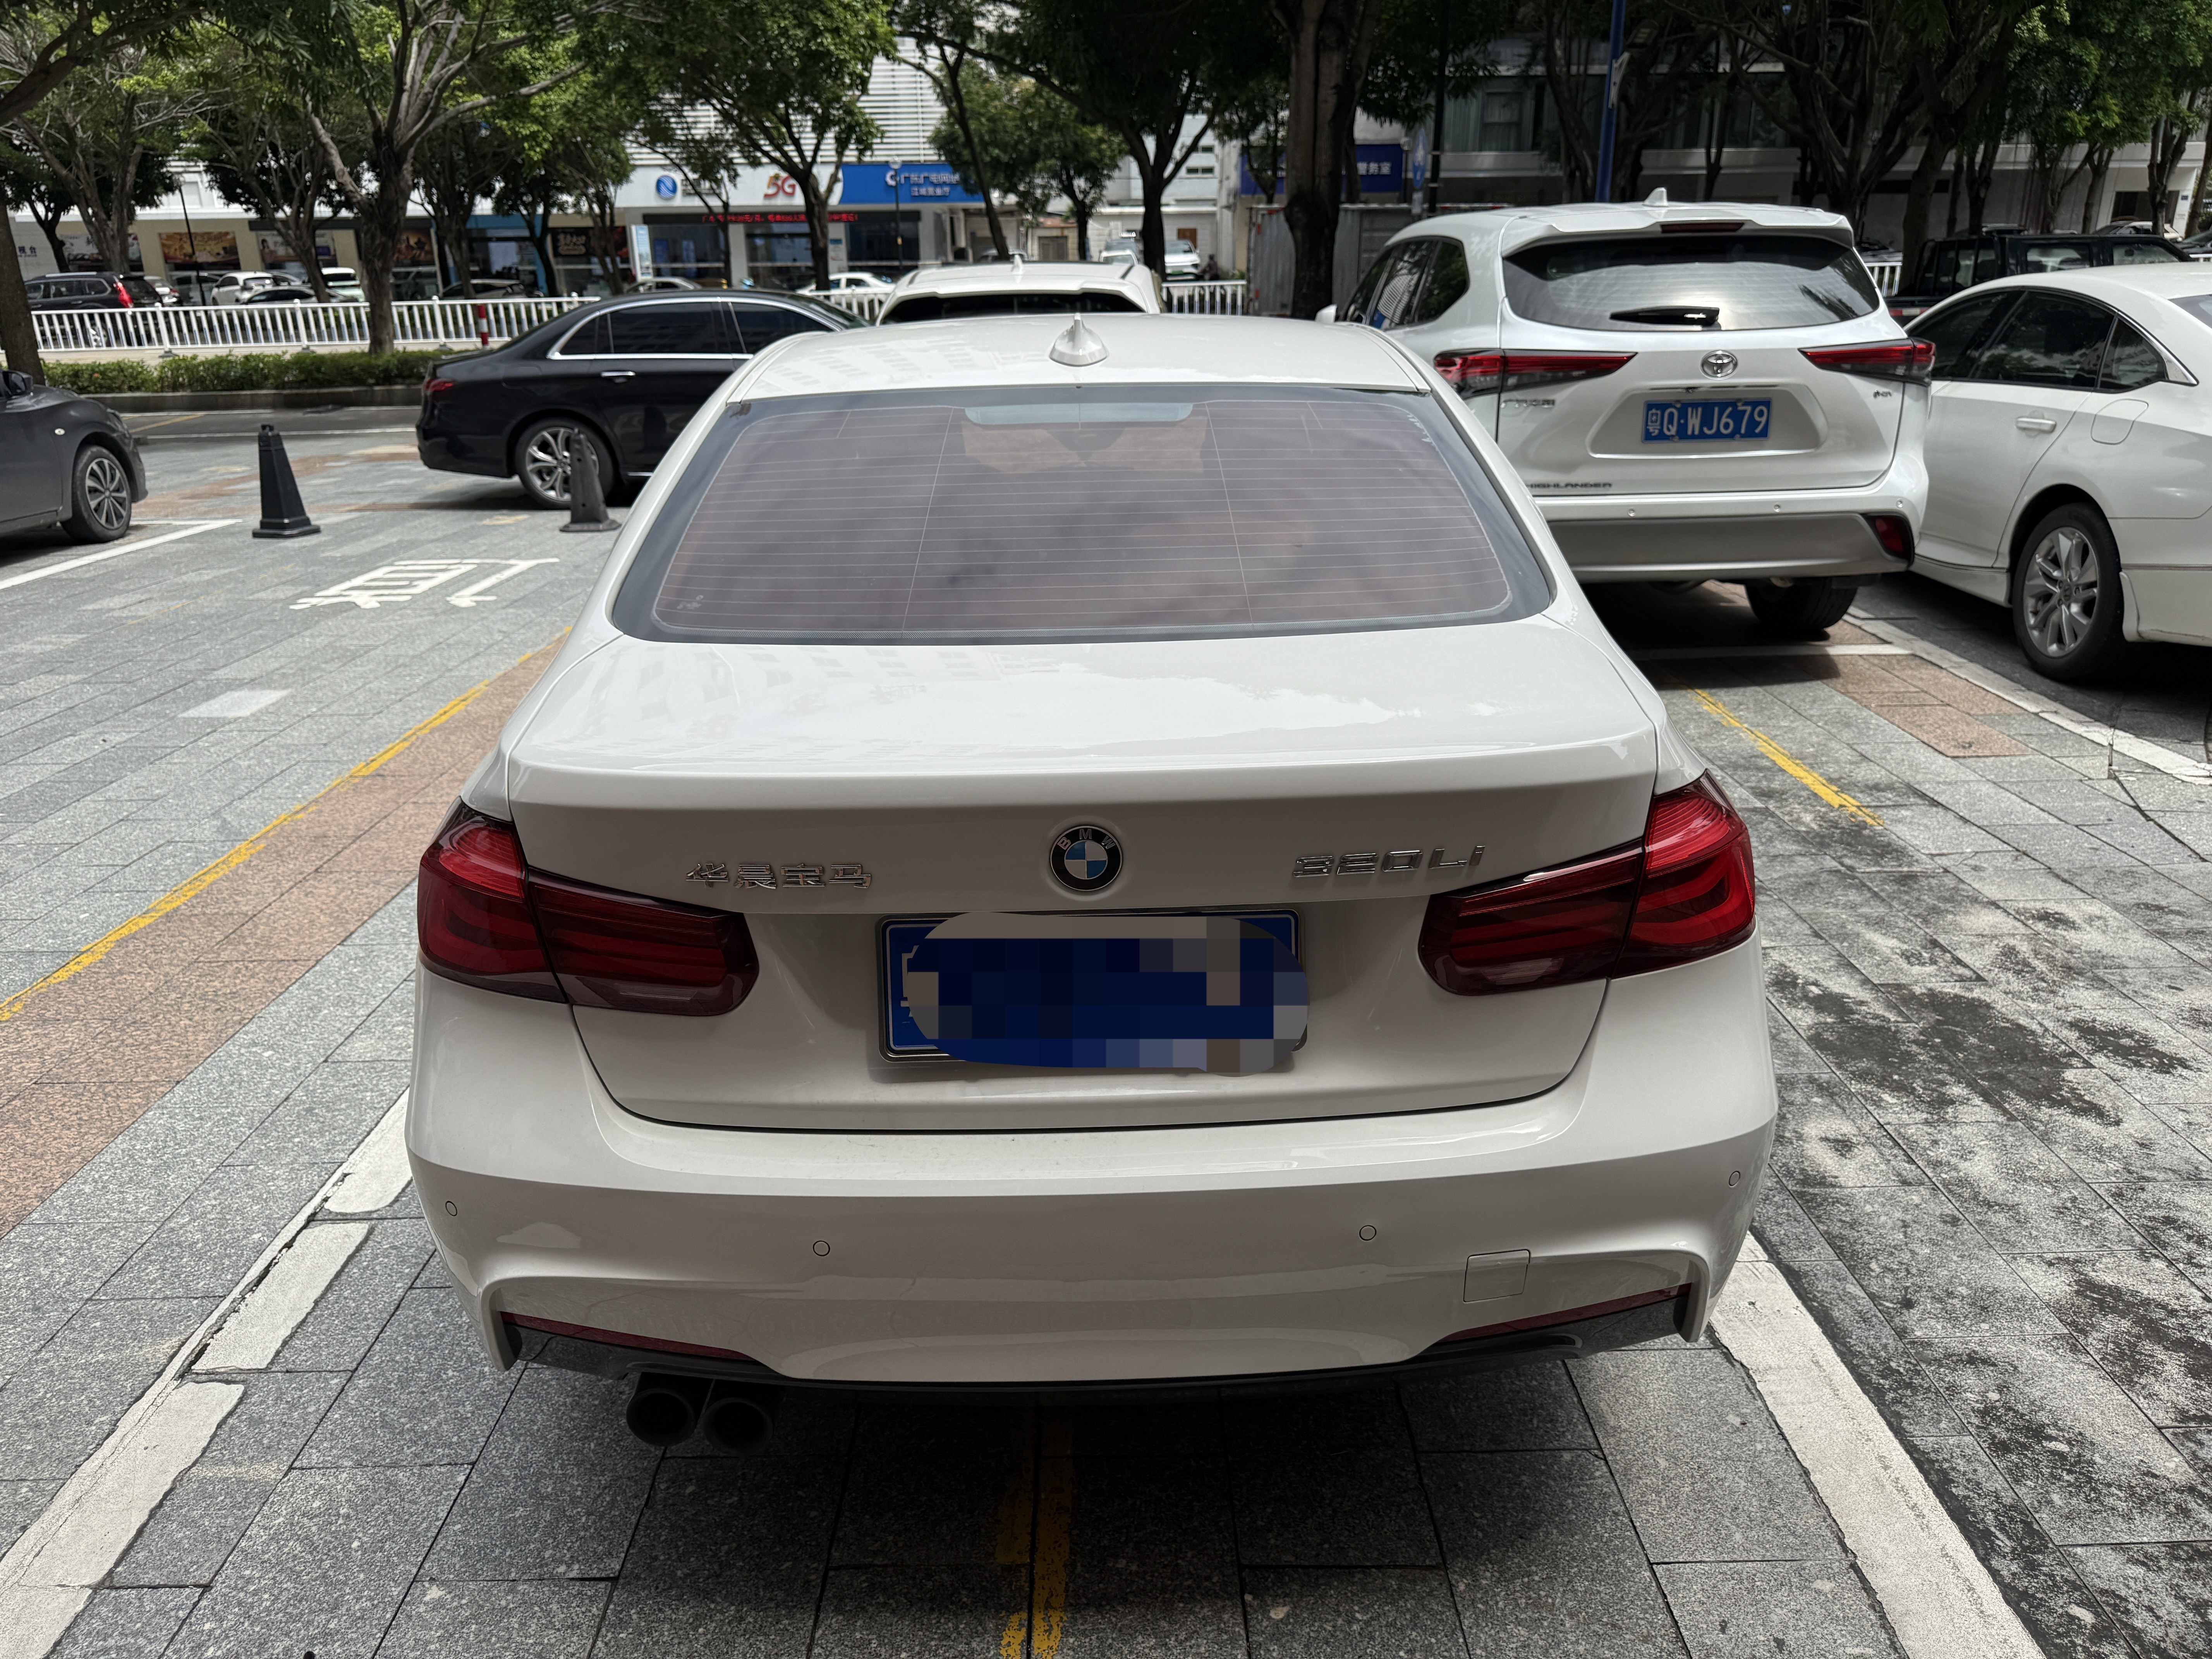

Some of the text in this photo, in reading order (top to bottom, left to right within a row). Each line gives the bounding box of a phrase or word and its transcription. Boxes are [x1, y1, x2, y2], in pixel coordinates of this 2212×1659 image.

[764, 175, 796, 198] 5G
[1647, 405, 1768, 436] 粤Q·WJ679
[1057, 829, 1116, 850] BMW
[1292, 845, 1486, 878] 320Li
[685, 863, 871, 889] 华晨宝马
